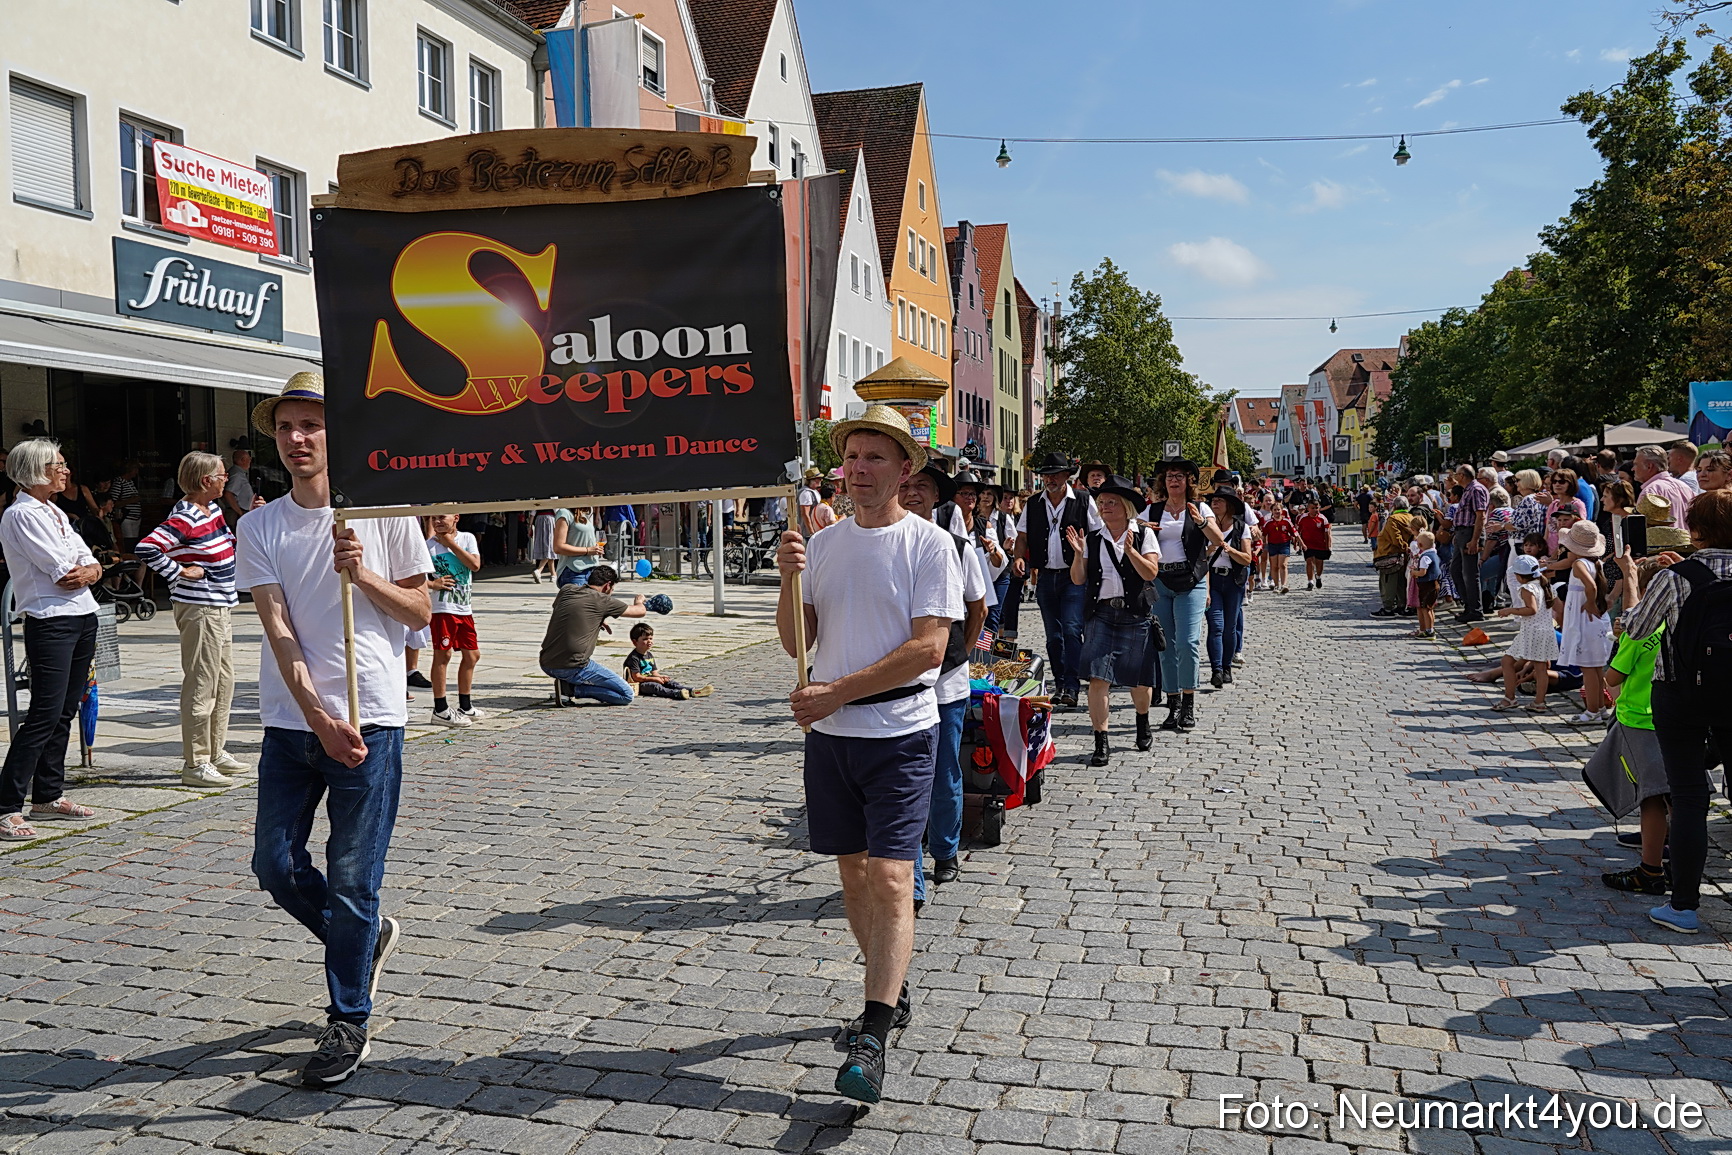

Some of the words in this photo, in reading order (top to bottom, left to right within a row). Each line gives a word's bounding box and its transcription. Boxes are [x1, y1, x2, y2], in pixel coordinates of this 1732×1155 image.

[161, 152, 215, 181] Suche
[221, 168, 267, 199] Mieter!
[212, 224, 234, 238] 09181
[242, 232, 257, 244] 509
[259, 236, 274, 248] 390
[128, 256, 279, 330] frühauf
[367, 446, 493, 473] Country
[500, 443, 528, 466] &
[532, 439, 658, 463] Western
[664, 434, 758, 457] Dance
